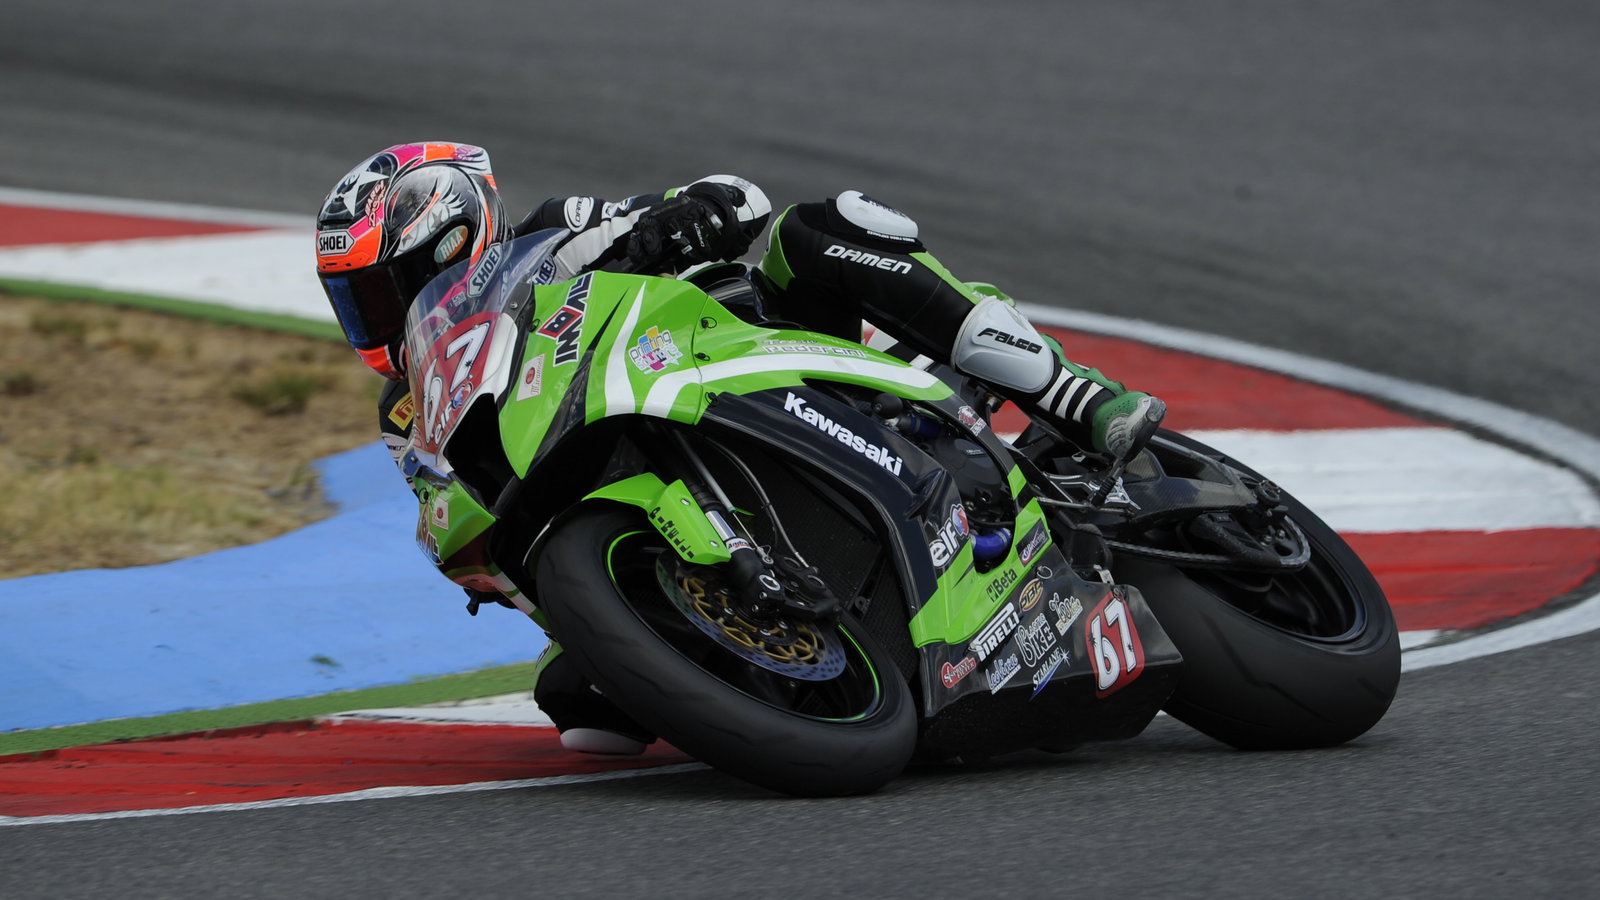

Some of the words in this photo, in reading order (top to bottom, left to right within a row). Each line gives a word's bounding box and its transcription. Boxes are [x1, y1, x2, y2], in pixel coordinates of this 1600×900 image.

[319, 236, 347, 251] SHOEI
[824, 244, 912, 275] DAMEN
[472, 249, 500, 292] SHOEI
[532, 261, 555, 287] HOEI
[423, 321, 492, 446] 67
[784, 392, 903, 476] Kawasaki
[930, 525, 961, 567] elf
[994, 568, 1018, 597] Beta
[976, 602, 1020, 662] PIRELLI
[1091, 600, 1137, 690] 67
[1033, 649, 1062, 691] STARLANE
